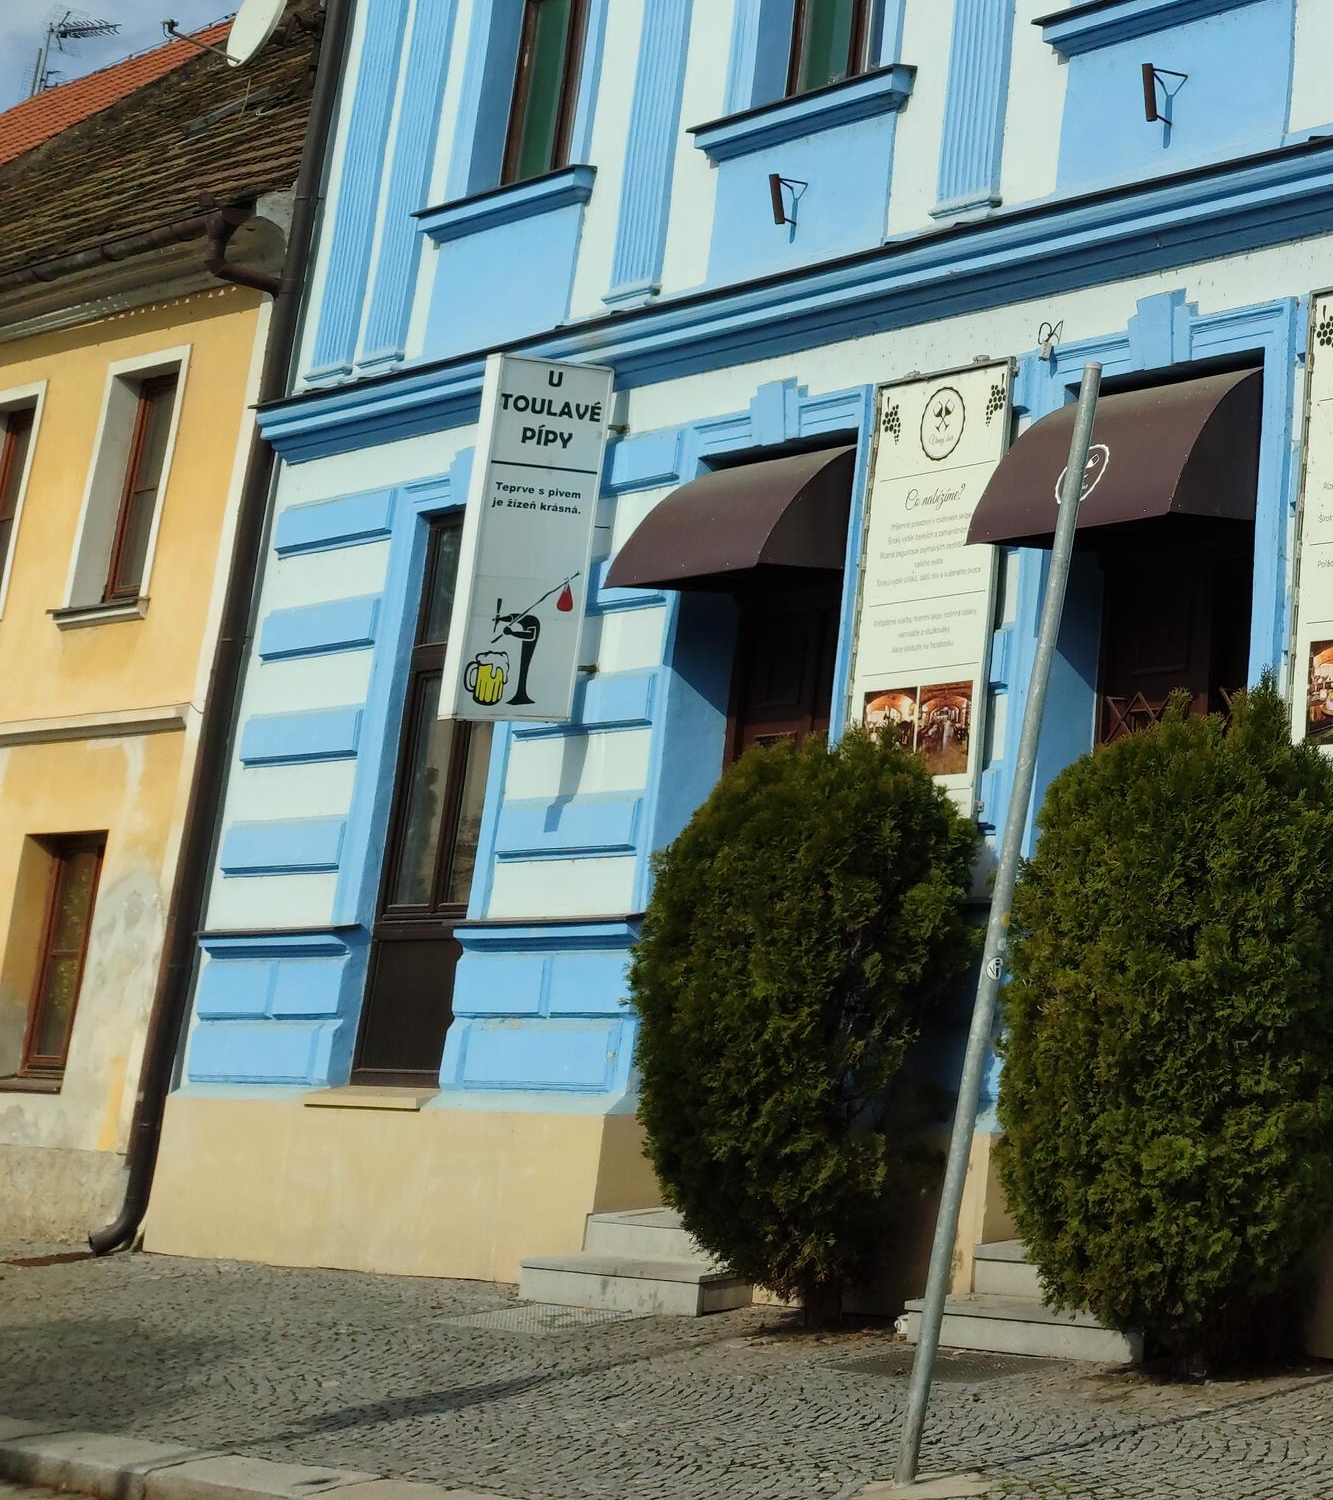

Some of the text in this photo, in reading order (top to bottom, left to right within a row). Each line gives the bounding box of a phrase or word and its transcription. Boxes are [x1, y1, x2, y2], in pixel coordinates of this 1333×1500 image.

[549, 371, 563, 387] U
[501, 393, 602, 422] TOULAVÉ
[521, 425, 573, 448] PÍPY
[496, 482, 535, 493] Teprve
[548, 487, 581, 499] pivem
[492, 497, 581, 515] je žízeň krásná.
